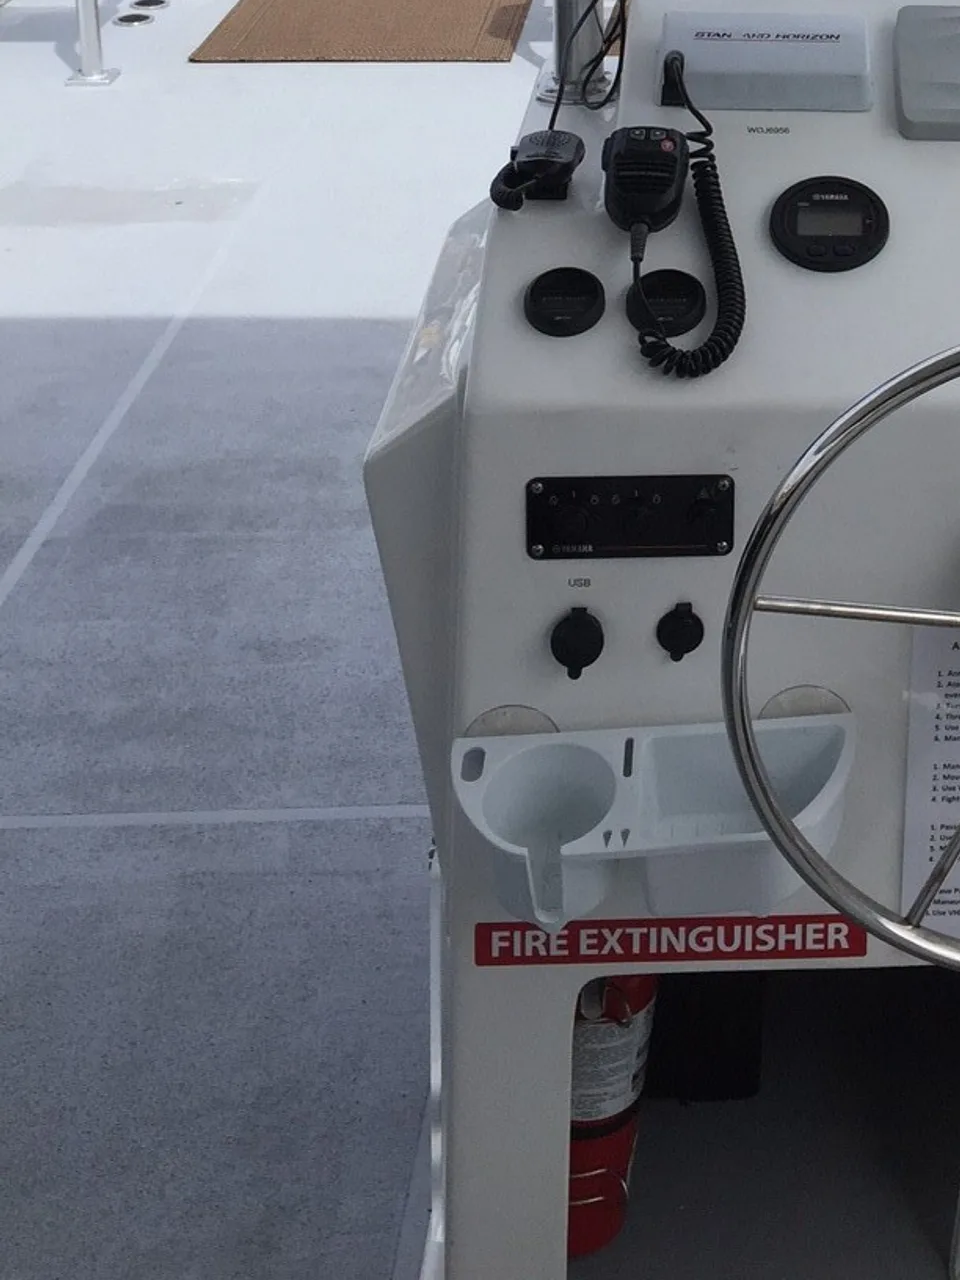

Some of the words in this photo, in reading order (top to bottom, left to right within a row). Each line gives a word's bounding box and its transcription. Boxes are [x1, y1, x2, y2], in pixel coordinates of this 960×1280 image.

[694, 31, 771, 40] STANARD
[775, 33, 841, 41] HORIZON
[567, 578, 591, 588] USB
[490, 928, 569, 958] FIRE
[579, 923, 850, 956] EXTINGUISHER
